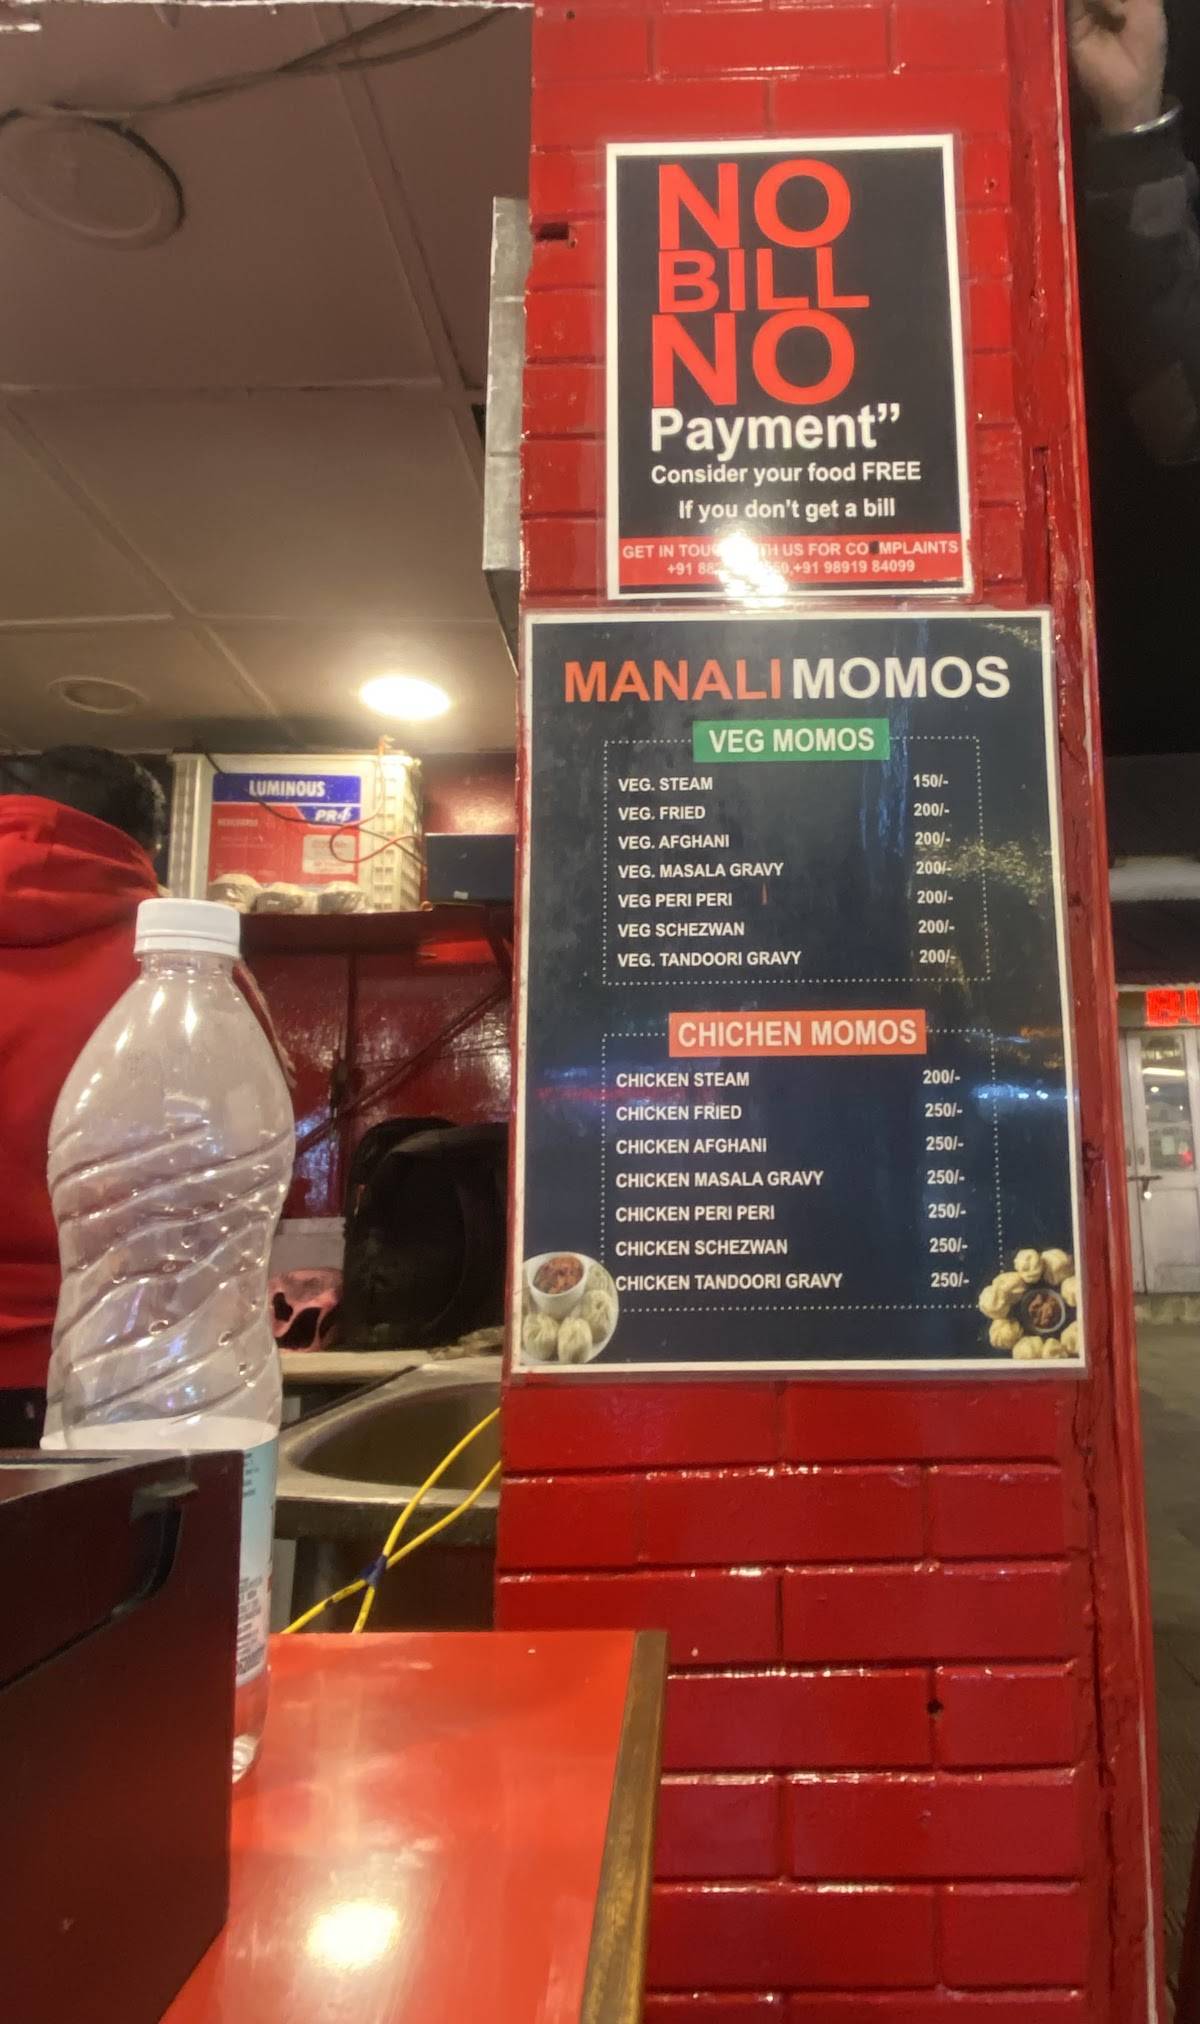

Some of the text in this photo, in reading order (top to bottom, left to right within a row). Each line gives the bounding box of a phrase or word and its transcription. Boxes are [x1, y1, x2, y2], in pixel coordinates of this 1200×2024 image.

[659, 159, 851, 249] NO
[659, 247, 869, 313] BILL
[652, 309, 855, 408] NO
[652, 461, 921, 487] Consider your food FREE
[680, 498, 895, 522] If you don't get a bill
[623, 545, 655, 558] GET
[659, 544, 674, 557] IN
[679, 544, 731, 558] TOUC
[782, 543, 804, 556] US
[808, 542, 841, 556] FOR
[667, 562, 693, 576] +91
[824, 560, 867, 574] 98919
[872, 559, 915, 573] 84099
[566, 656, 1009, 702] MANALI MOMOS
[709, 727, 874, 752] VEG MOMOS
[249, 780, 326, 798] LUMINOUS
[618, 774, 948, 791] VEG. STEAM 150/-
[618, 803, 949, 820] VEG. FRIED 200/-
[618, 832, 950, 849] VEG. AFGHANI 200/-
[618, 861, 952, 878] VEG. MASALA GRAVY 200/-
[618, 890, 953, 907] VEG PERI PERI 200/-
[618, 920, 954, 937] VEG SCHEZWAN 200/-
[618, 950, 956, 967] VEG. TANDOORI GRAVY 200/-
[679, 1020, 916, 1047] CHICHEN MOMOS
[616, 1070, 960, 1087] CHICKEN STEAM 200/-
[616, 1103, 962, 1120] CHICKEN FRIED 250/-
[616, 1136, 963, 1154] CHICKEN AFGHANI 250/-
[616, 1170, 964, 1188] CHICKEN MASALA GRAVY 250/-
[616, 1204, 966, 1222] CHICKEN PERI PERI 250/-
[616, 1238, 967, 1256] CHICKEN SCHEZWAN 250/-
[616, 1272, 969, 1290] CHICKEN TANDOORI GRAVY 250/-
